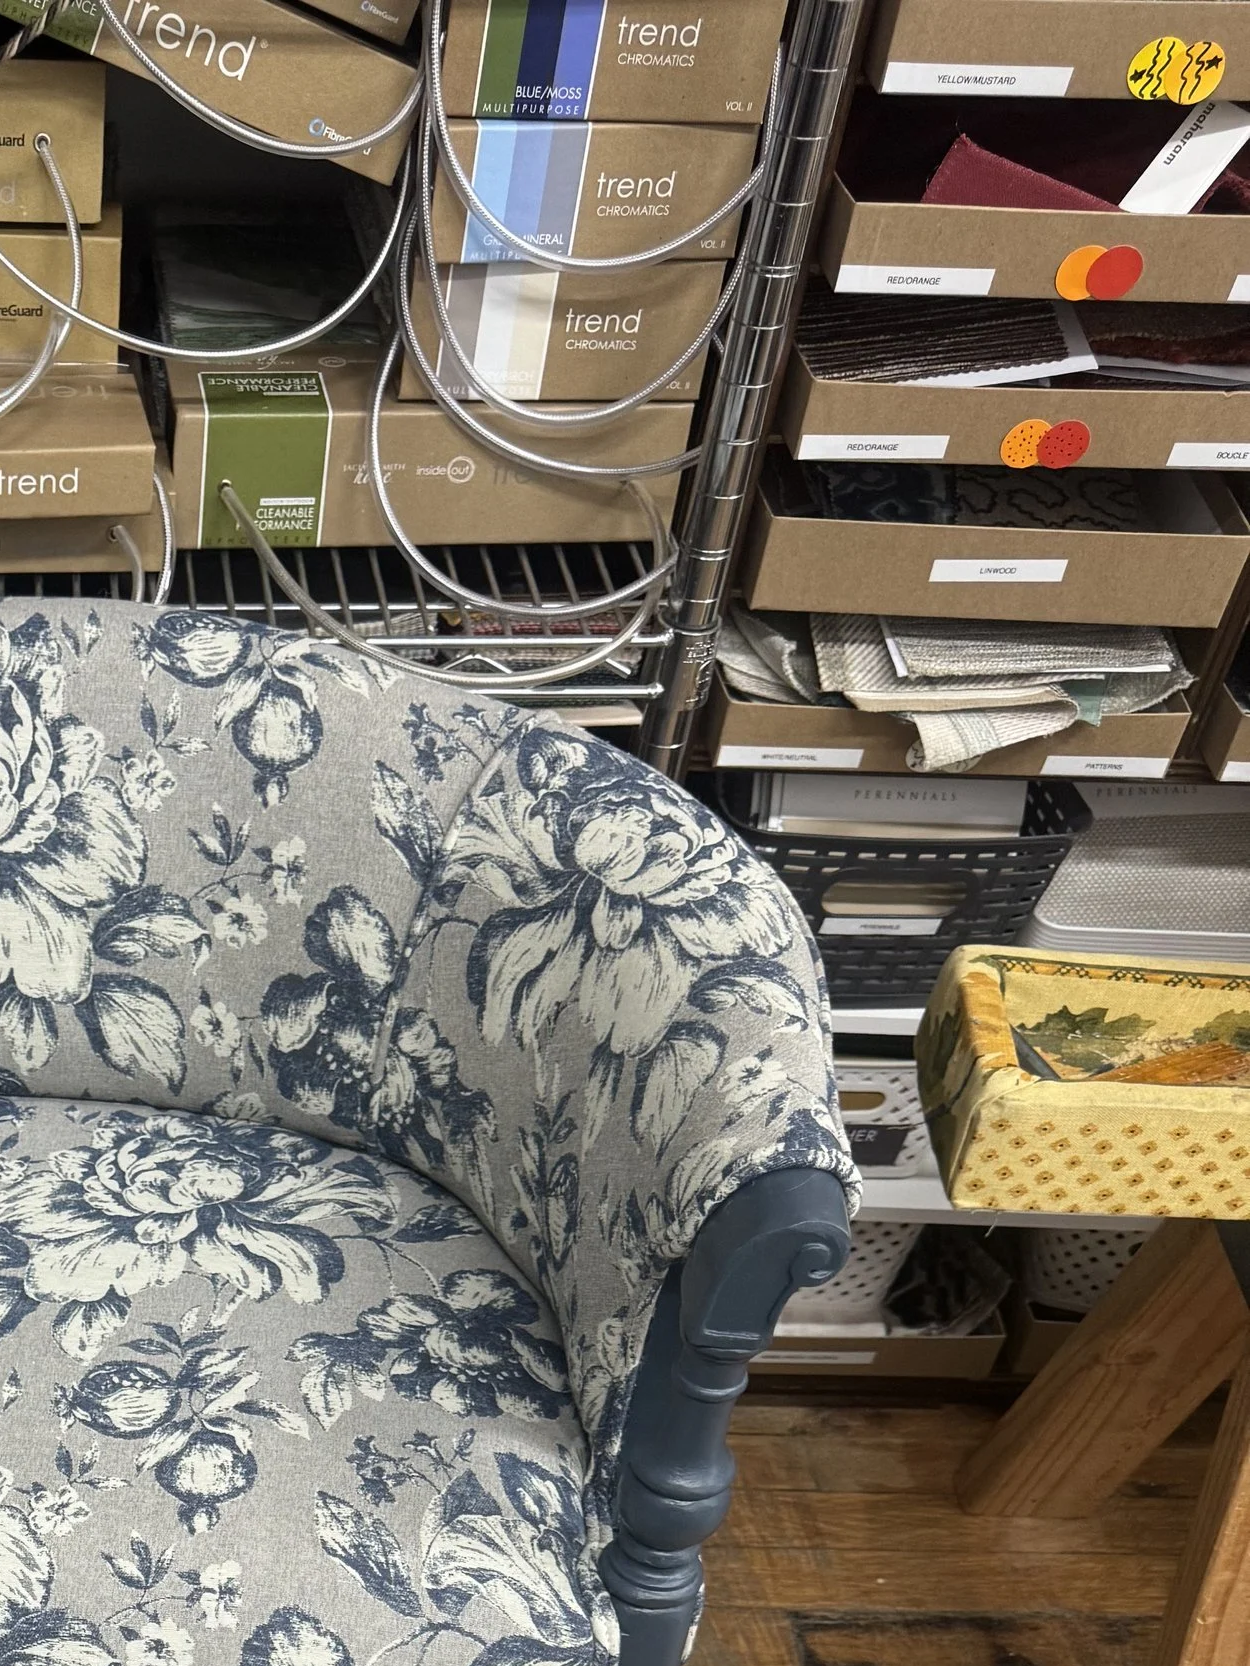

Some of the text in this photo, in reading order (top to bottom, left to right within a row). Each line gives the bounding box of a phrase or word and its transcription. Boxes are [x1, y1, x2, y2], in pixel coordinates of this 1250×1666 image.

[618, 16, 702, 48] trend
[617, 53, 695, 67] CHROMATICS
[937, 74, 1017, 86] YELLOW/MUSTARD
[515, 85, 582, 99] BLUE/MOSS
[482, 103, 580, 115] MULTIPURPOSE
[725, 101, 745, 112] VOL.
[1163, 102, 1216, 166] maharam
[596, 170, 676, 199] trend
[596, 204, 670, 217] CHROMATICS
[700, 239, 720, 249] VOL.
[886, 275, 942, 285] RED/ORANGE
[566, 308, 643, 334] trend
[565, 339, 637, 351] CHROMATICS
[206, 376, 317, 386] PERFORMANCE
[846, 443, 899, 452] RED/ORANGE
[416, 464, 470, 476] inside out
[256, 507, 315, 519] CLEANABLE
[979, 567, 1017, 575] LINWOOD
[1084, 762, 1124, 772] PATTERNS
[854, 789, 958, 802] PERENNIALS
[1096, 785, 1199, 798] PERENNIALS
